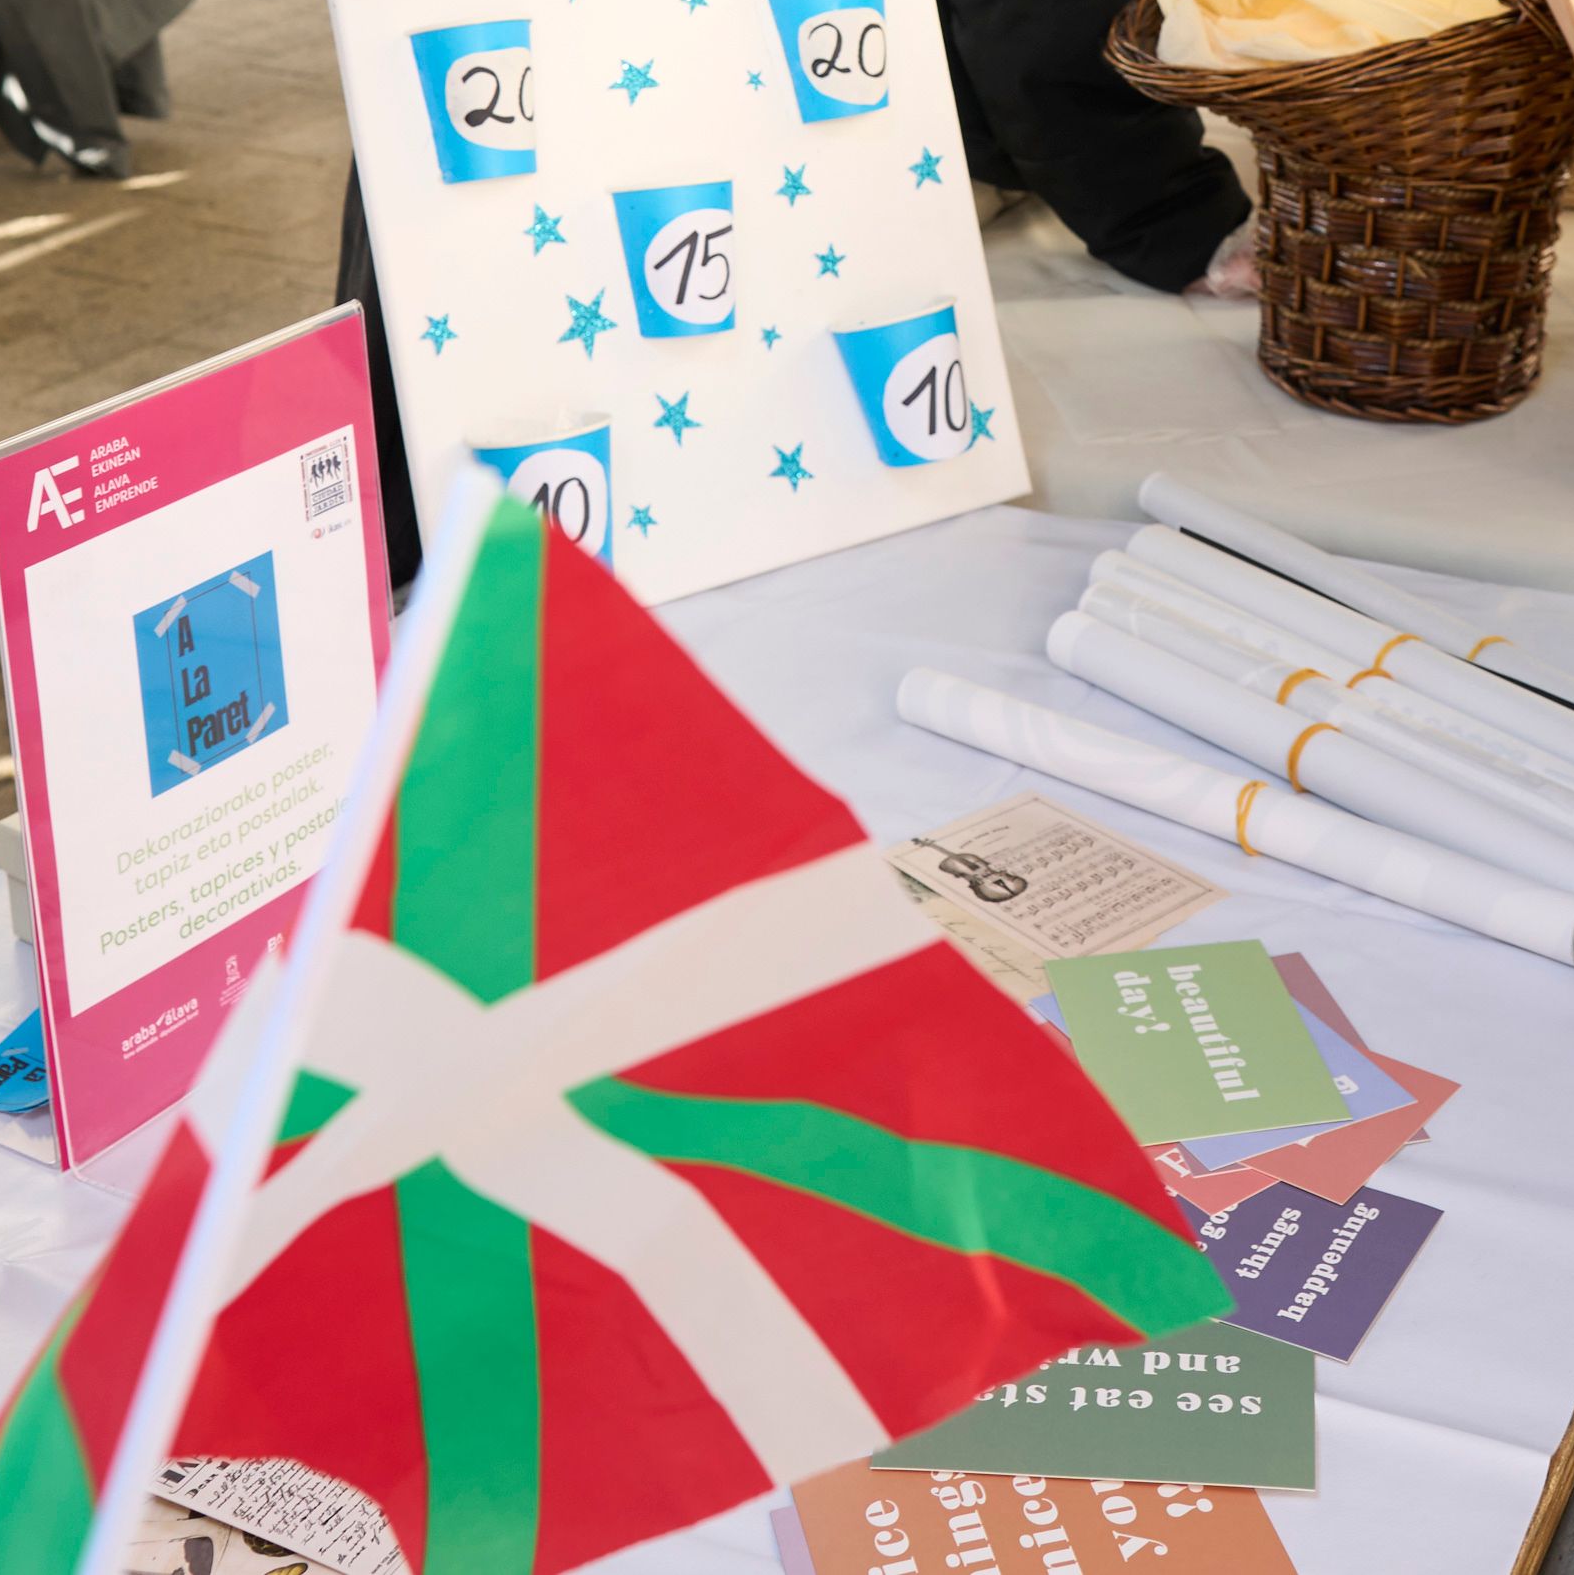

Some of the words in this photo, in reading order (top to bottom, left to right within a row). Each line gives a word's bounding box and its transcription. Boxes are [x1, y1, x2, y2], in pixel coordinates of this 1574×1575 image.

[808, 22, 887, 80] 20
[654, 225, 733, 307] 15
[901, 359, 966, 433] 10
[90, 436, 129, 462] ARABA
[91, 447, 141, 478] EKINEAN
[94, 473, 130, 498] ALAVA
[95, 476, 159, 514] EMPRENDE
[178, 615, 195, 657] A
[182, 665, 211, 707] La
[187, 690, 251, 757] Paret
[116, 781, 266, 874] Dekoraziorako
[135, 853, 192, 895] tapiz
[197, 832, 232, 861] eta
[190, 850, 265, 904] tapices
[268, 842, 281, 861] y
[179, 858, 302, 940] decorativas.
[1113, 971, 1171, 1034] day!
[122, 1023, 156, 1052] araba
[1167, 964, 1261, 1102] beautiful
[1235, 1207, 1302, 1279] things
[1277, 1202, 1380, 1323] happening
[1142, 1351, 1241, 1376] and
[1069, 1386, 1153, 1411] eat
[1176, 1391, 1262, 1416] see
